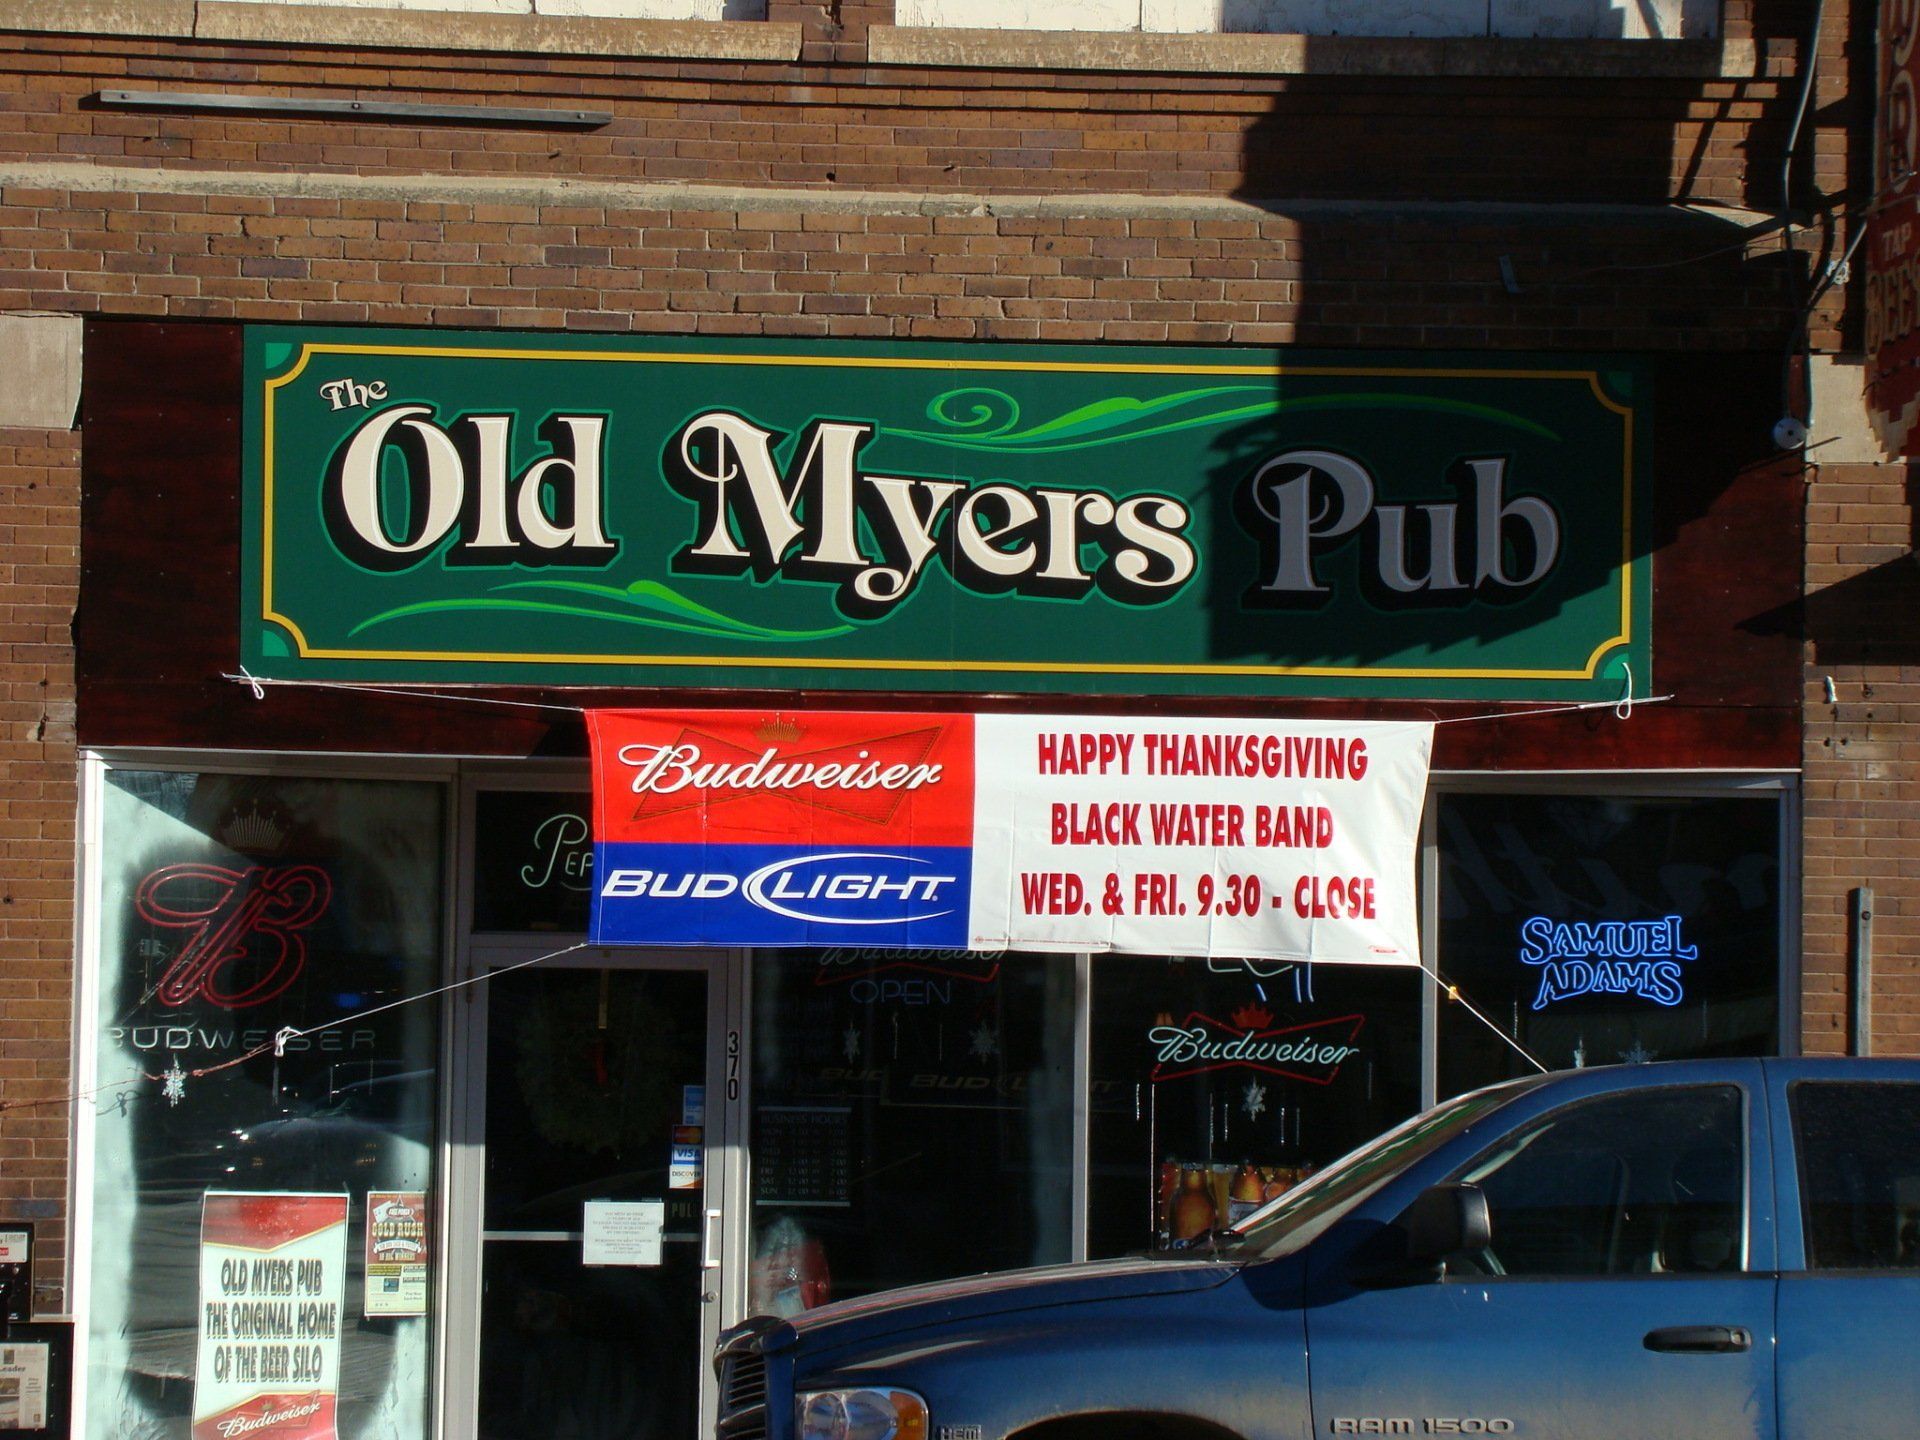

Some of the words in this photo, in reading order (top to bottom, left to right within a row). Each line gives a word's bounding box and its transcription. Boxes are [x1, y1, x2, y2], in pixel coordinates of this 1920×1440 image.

[319, 377, 389, 411] The
[338, 403, 617, 555] Old
[680, 411, 1196, 603] Myers
[1252, 449, 1560, 593] Pub
[617, 742, 944, 795] Budweiser
[1037, 732, 1136, 776] HAPPY
[1143, 733, 1369, 782] THANKSGIVING
[1050, 802, 1142, 846] BLACK
[1149, 803, 1246, 847] WATER
[1255, 804, 1335, 849] BAND
[601, 868, 740, 899] BUD
[768, 870, 957, 902] LIGHT
[1020, 872, 1093, 916] WED.
[1101, 872, 1125, 916] &
[1134, 872, 1187, 916] FRI.
[1197, 873, 1262, 918] 9.30
[1293, 874, 1377, 920] CLOSE
[1519, 914, 1699, 966] SAMUEL
[849, 979, 951, 1006] OPEN
[1531, 958, 1684, 1012] ADAMS
[1148, 1025, 1361, 1065] Budweiser
[728, 1031, 740, 1101] 370
[677, 1149, 701, 1159] VISA
[220, 1257, 250, 1296] OLD
[250, 1257, 294, 1297] MYERS
[296, 1257, 323, 1296] PUB
[205, 1302, 229, 1340] THE
[231, 1302, 294, 1340] ORIGINAL
[297, 1302, 337, 1340] HOME
[214, 1344, 233, 1384] OF
[234, 1344, 258, 1384] THE
[259, 1344, 291, 1384] BEER
[292, 1344, 324, 1384] SILO
[216, 1411, 321, 1440] Budweiser
[1331, 1417, 1415, 1435] RAM
[1422, 1417, 1515, 1435] 1500
